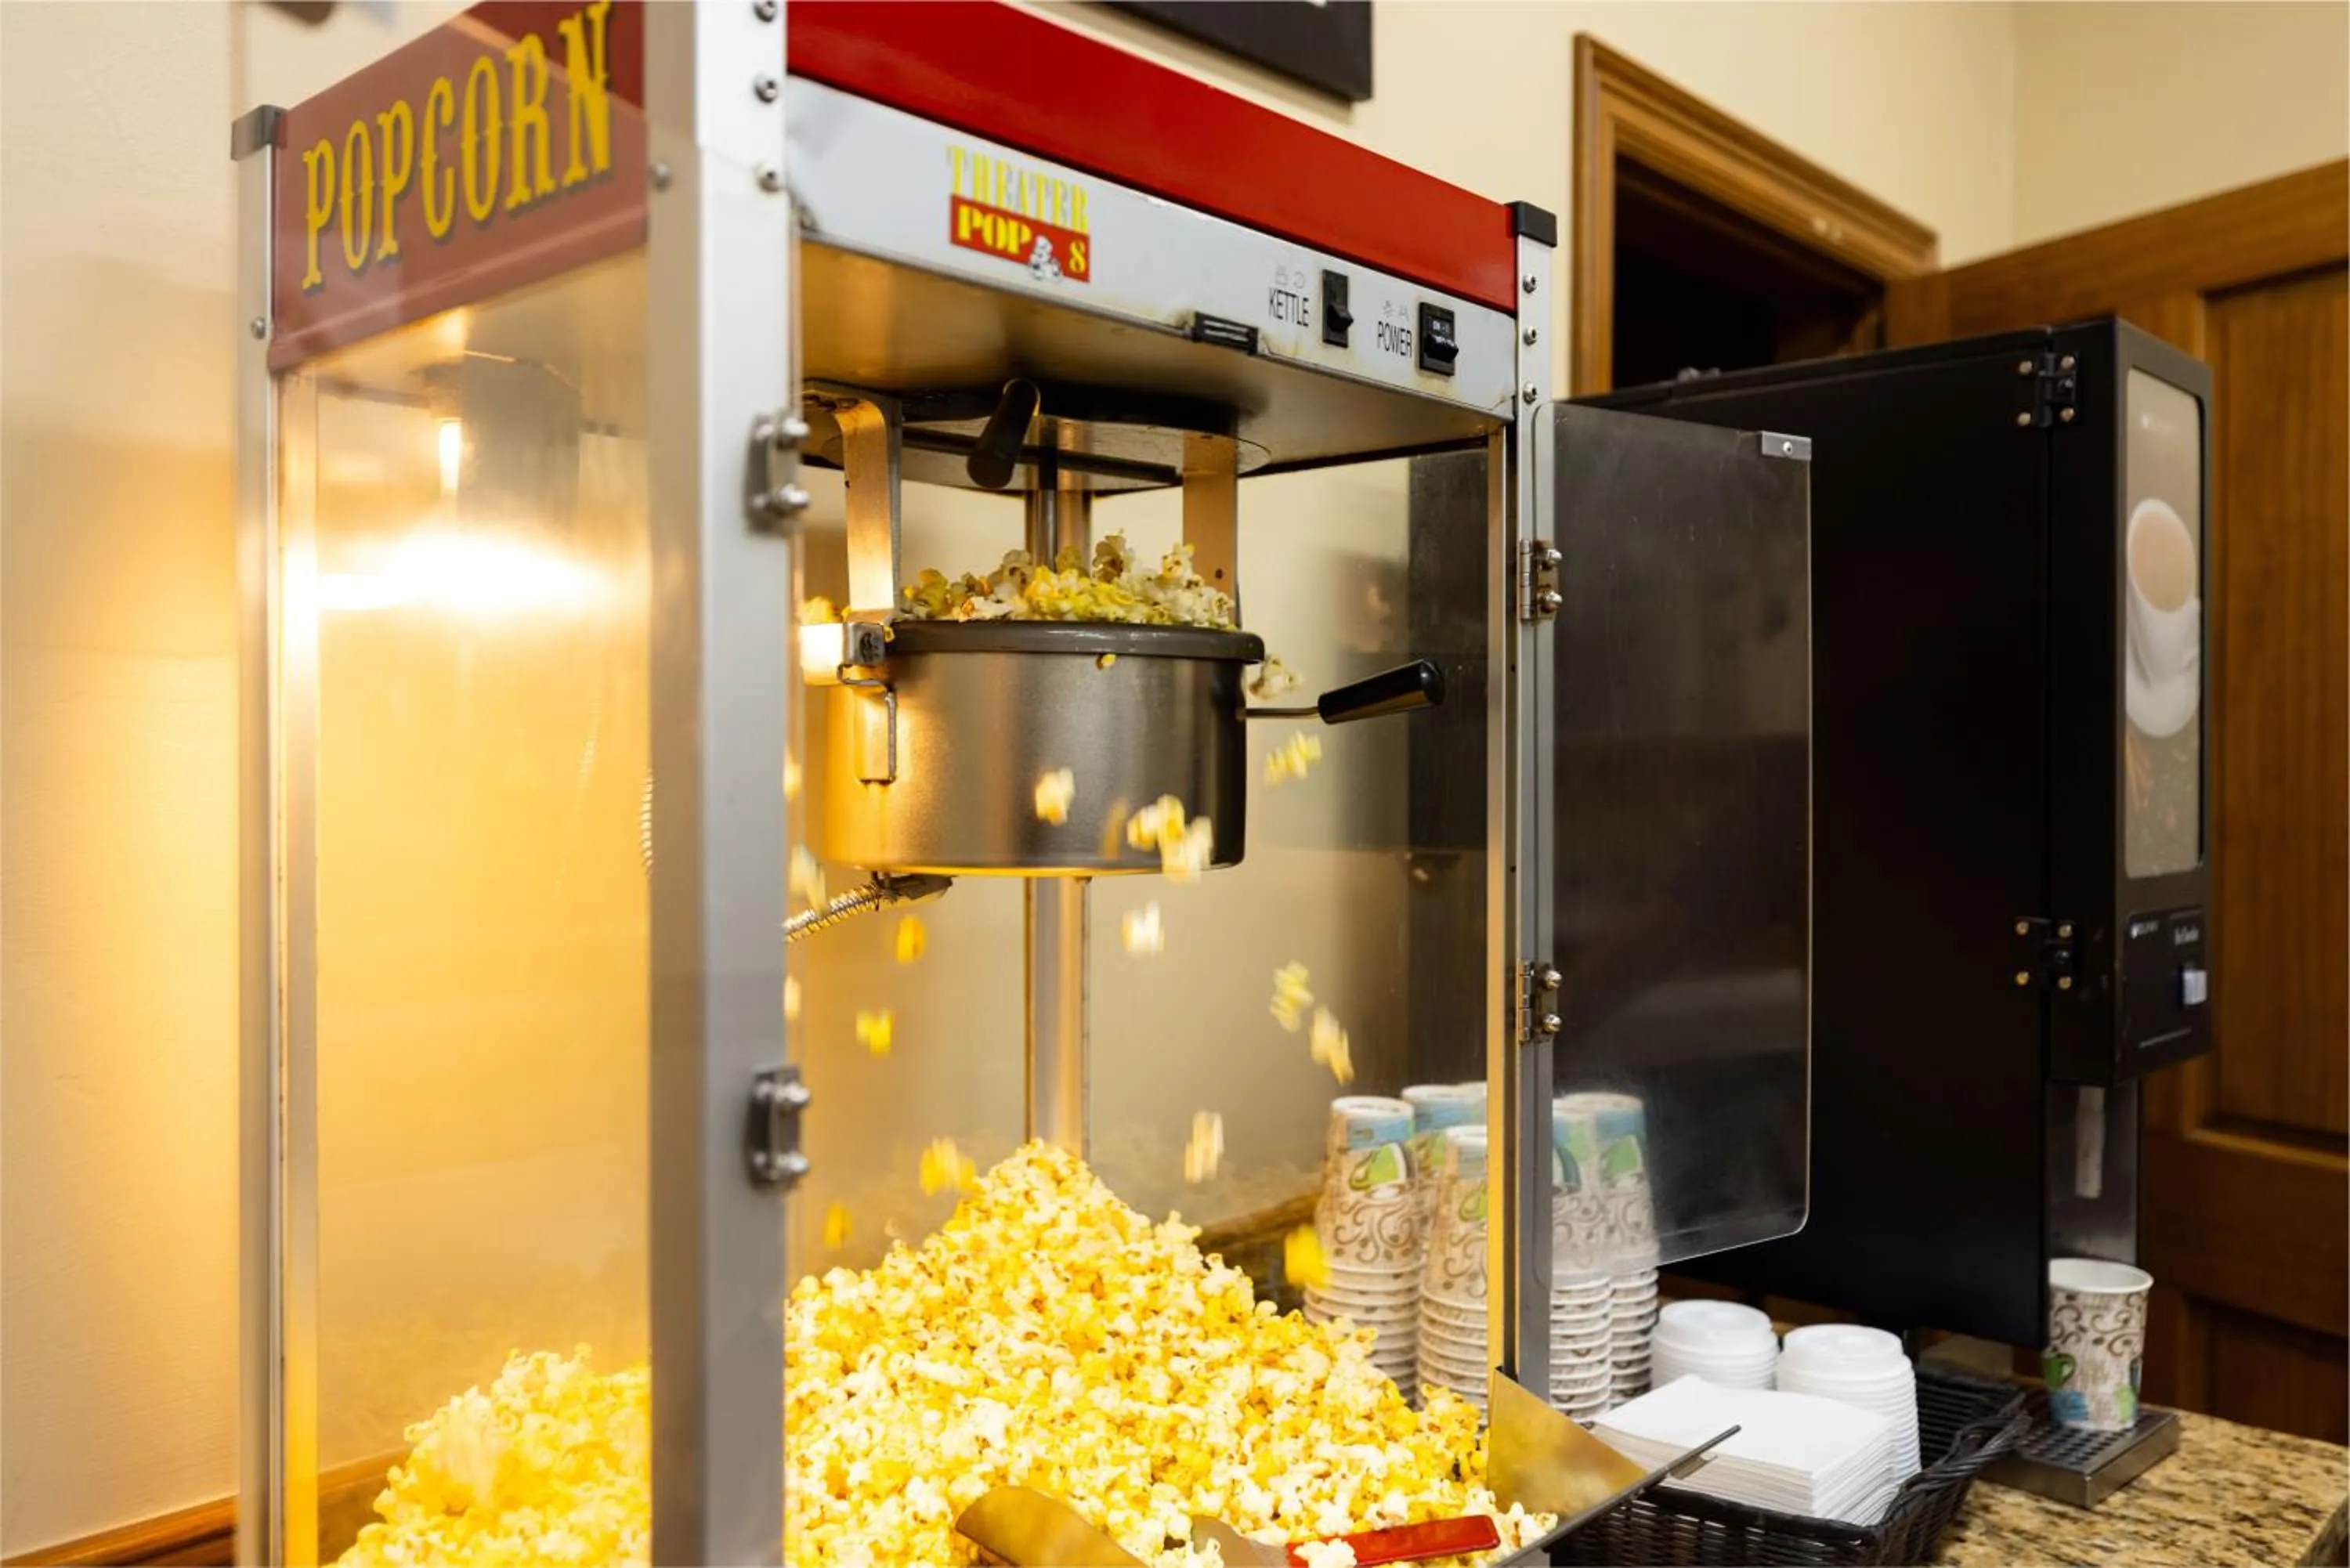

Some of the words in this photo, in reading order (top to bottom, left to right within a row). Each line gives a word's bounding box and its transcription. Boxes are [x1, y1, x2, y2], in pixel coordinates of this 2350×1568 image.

[302, 0, 613, 291] POPCORN
[946, 145, 1090, 234] THEATER
[958, 204, 1032, 255] POP
[1269, 287, 1310, 327] KETTLE
[1377, 321, 1412, 358] POWER
